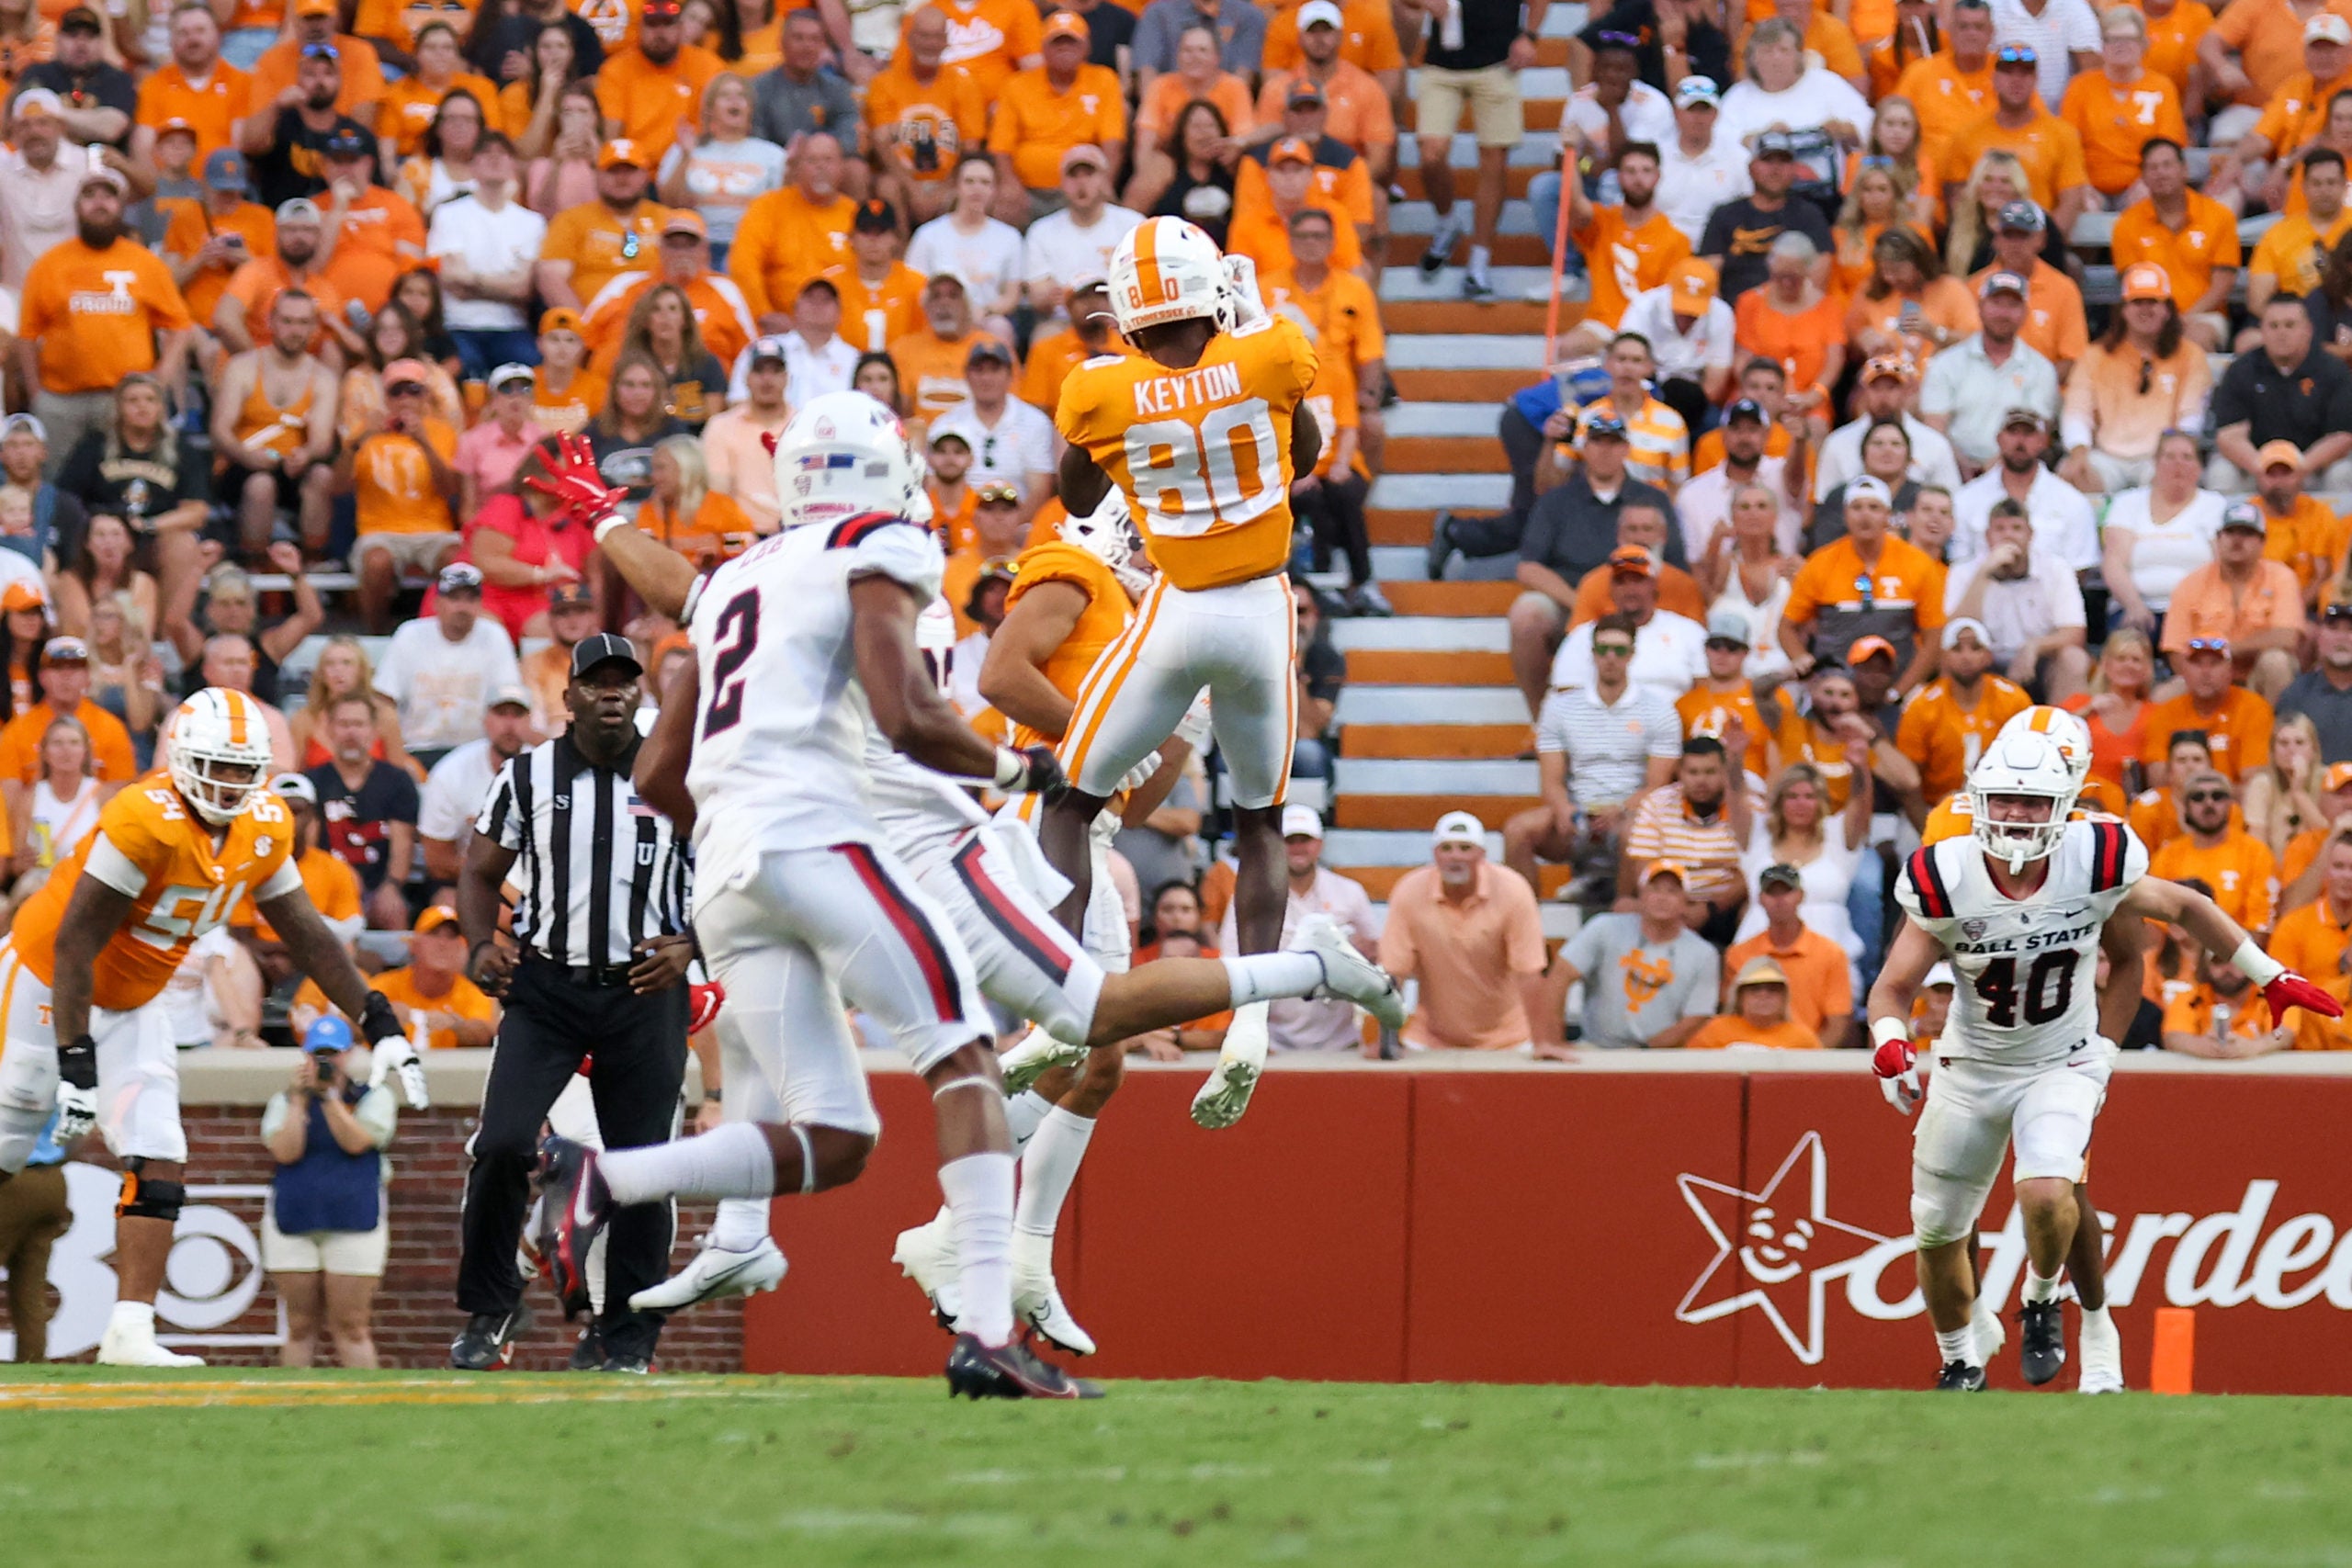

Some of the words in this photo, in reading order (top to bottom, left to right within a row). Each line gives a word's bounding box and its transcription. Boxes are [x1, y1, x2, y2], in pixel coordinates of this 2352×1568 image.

[2132, 90, 2164, 125] T
[103, 269, 138, 298] T
[1128, 286, 1142, 310] 8
[1165, 277, 1180, 301] 0
[1134, 361, 1241, 415] KEYTON
[1124, 397, 1286, 536] 80
[702, 583, 762, 744] 2
[555, 794, 571, 810] S
[638, 842, 655, 865] U
[1954, 940, 2018, 953] BALL
[2026, 921, 2097, 950] STATE
[1973, 948, 2081, 1028] 40
